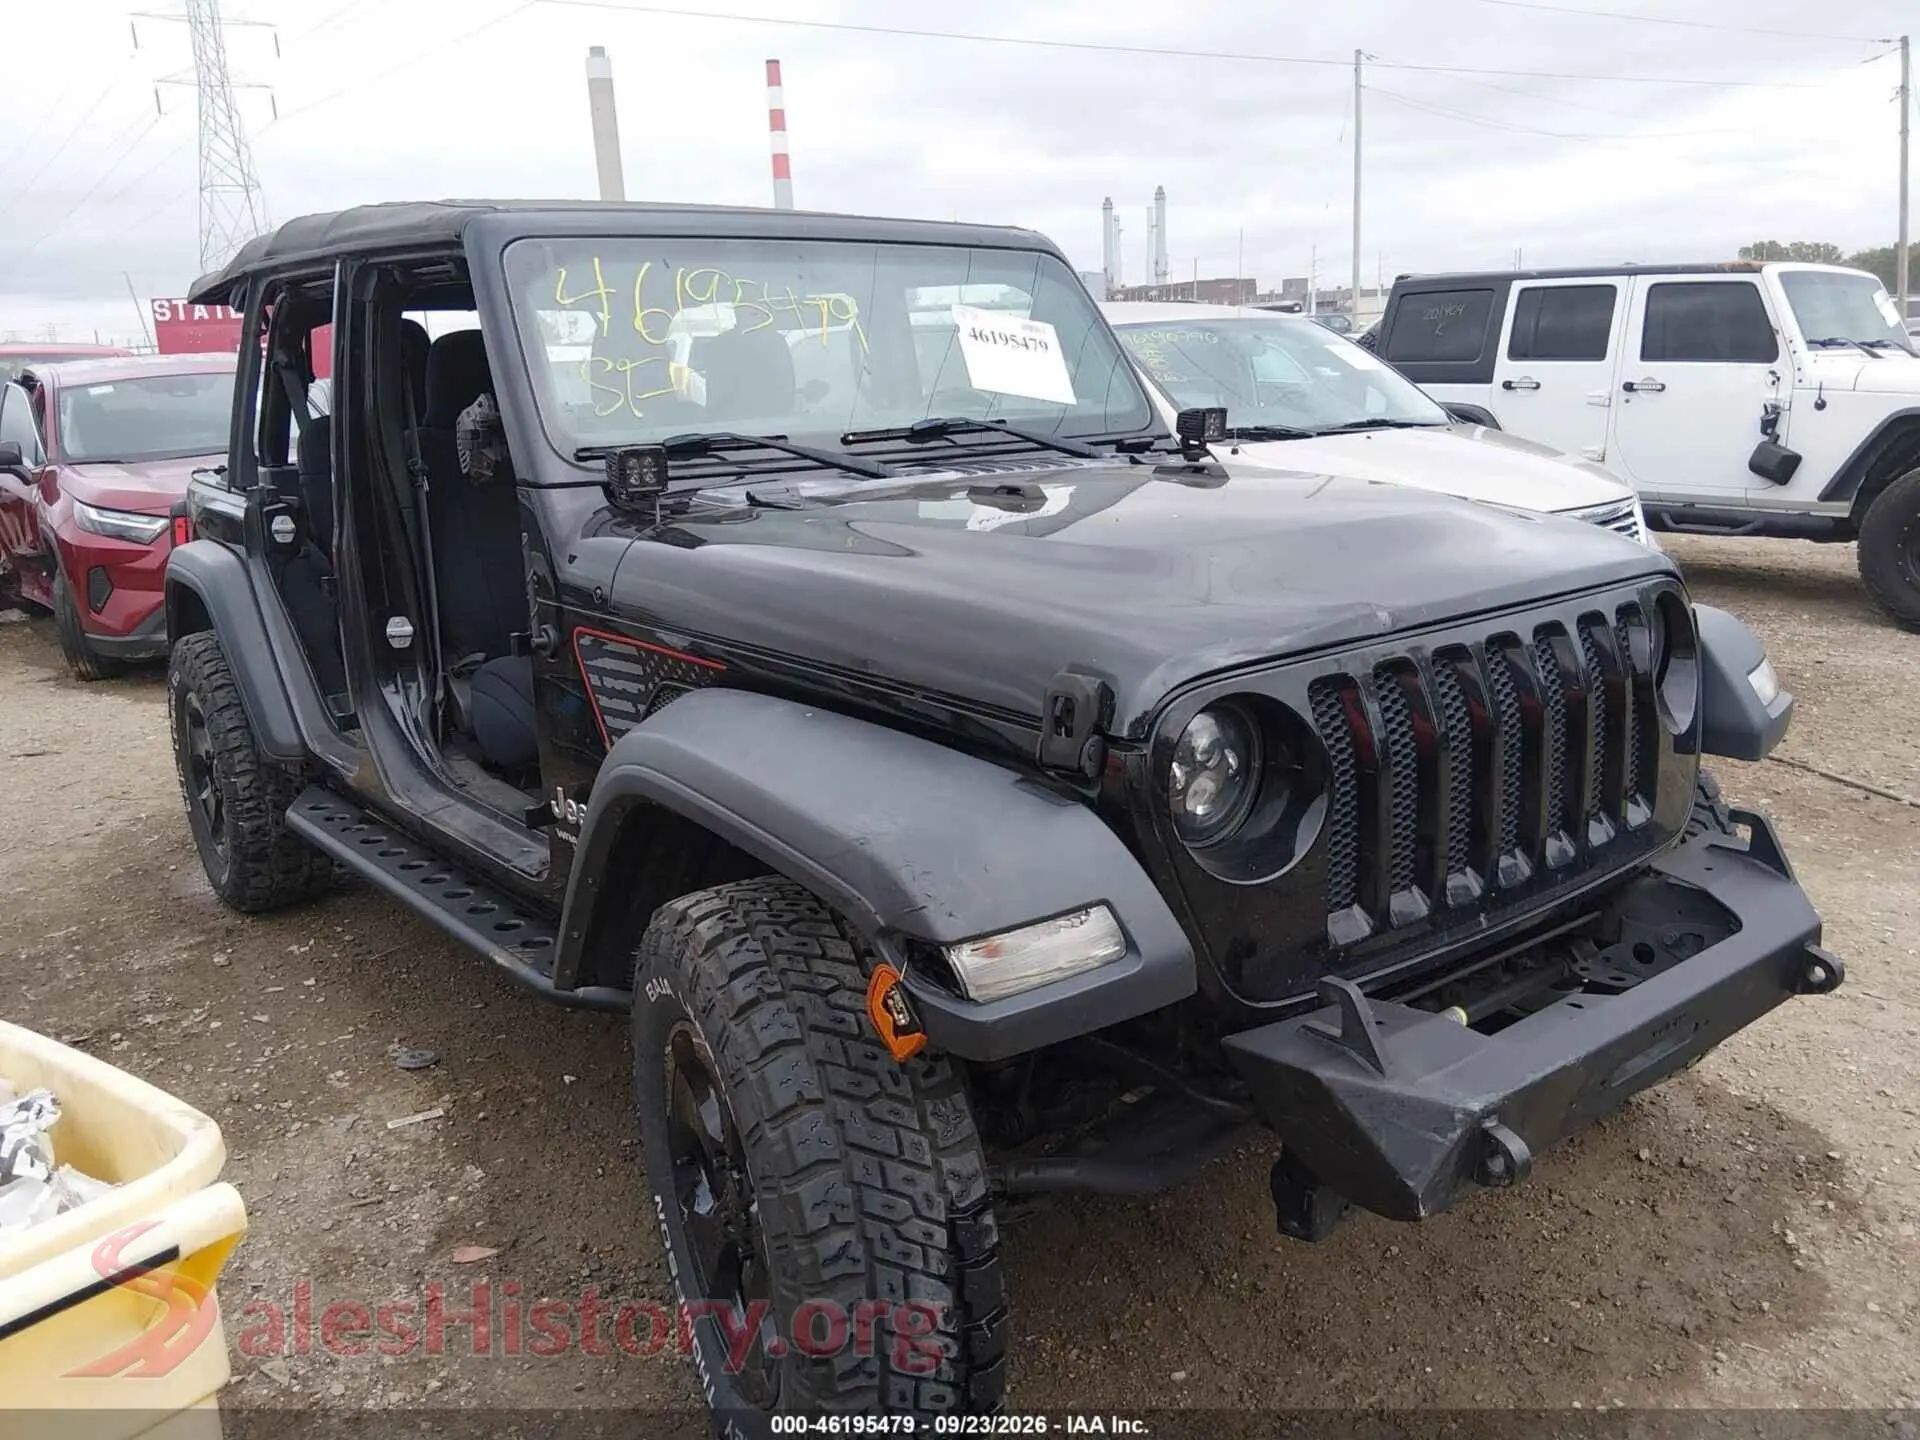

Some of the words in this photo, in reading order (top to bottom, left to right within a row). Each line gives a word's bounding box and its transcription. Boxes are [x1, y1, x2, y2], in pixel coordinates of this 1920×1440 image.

[555, 257, 870, 355] 46195479
[967, 326, 1049, 353] 46195479
[550, 786, 588, 825] Jee
[654, 1195, 716, 1409] THOMPSON
